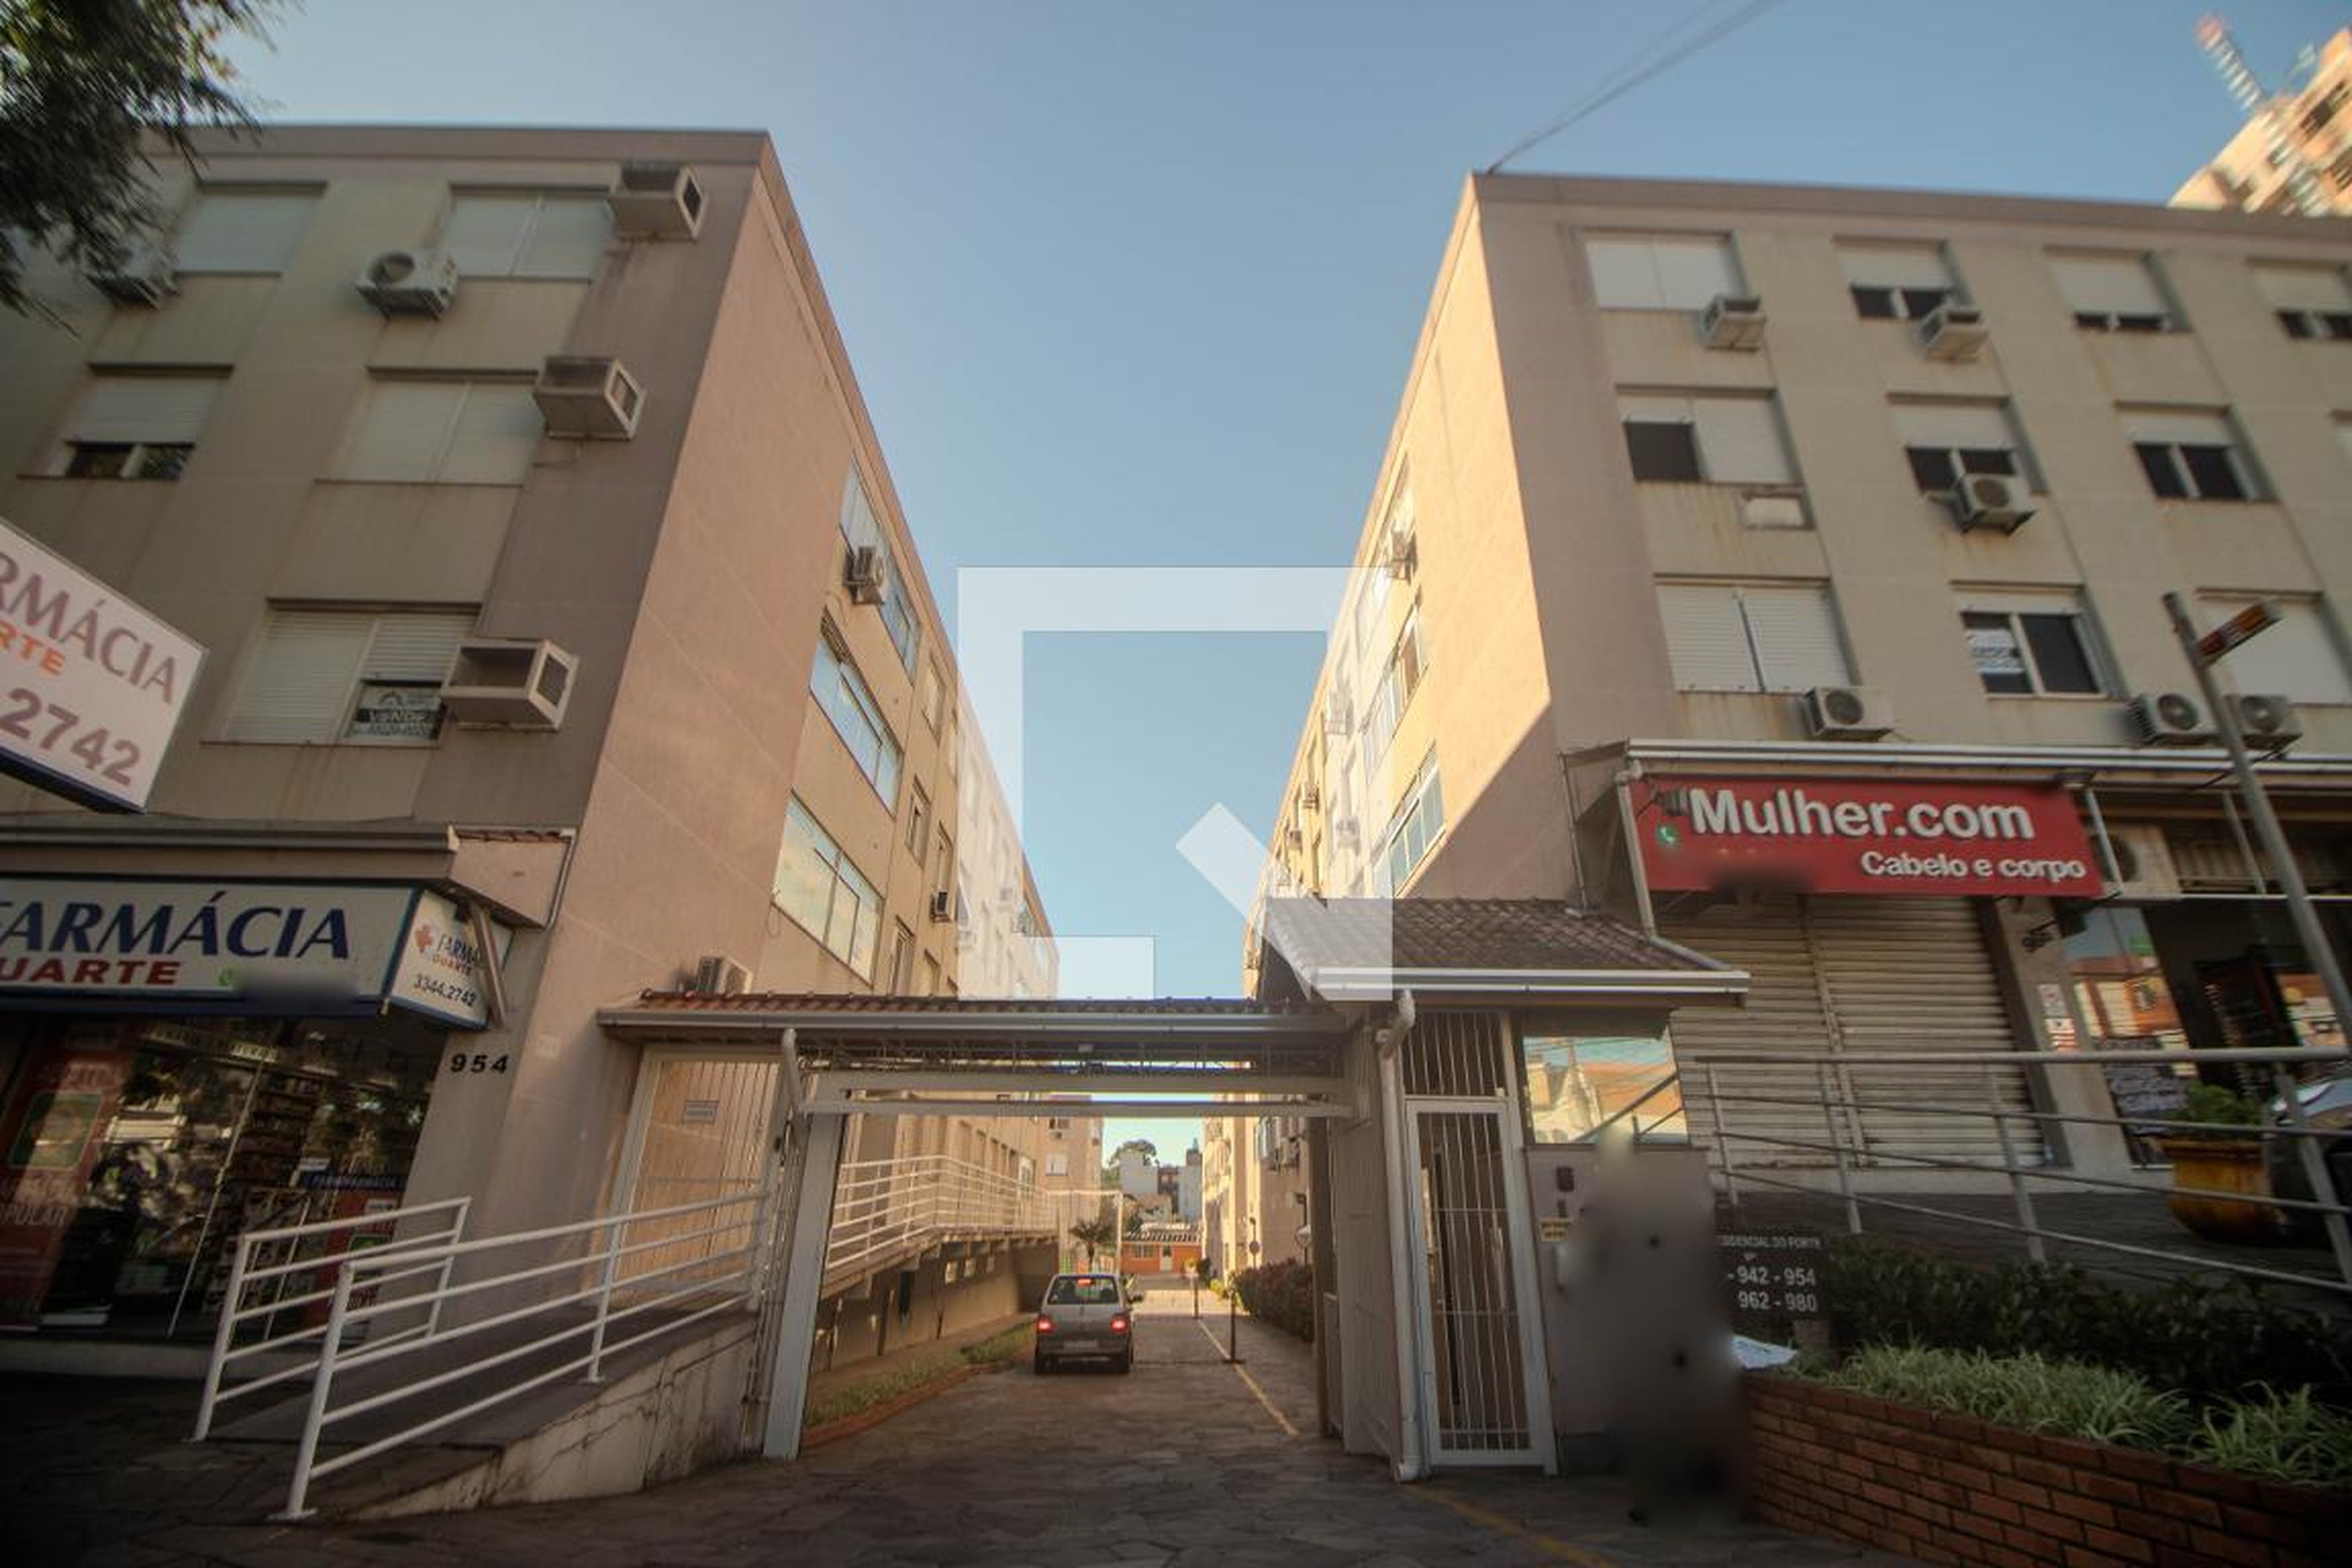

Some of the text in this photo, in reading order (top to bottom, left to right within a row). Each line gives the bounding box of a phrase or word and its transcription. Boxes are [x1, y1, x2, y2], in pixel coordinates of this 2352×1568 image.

[0, 688, 141, 786] 2742
[1688, 788, 2035, 839] Mulher.com
[1860, 850, 2087, 883] Cabelo e corpo
[450, 1052, 510, 1074] 954
[1736, 1265, 1770, 1285] 942
[1783, 1267, 1817, 1286] 954
[1738, 1289, 1771, 1310] 962
[1784, 1292, 1818, 1312] 980
